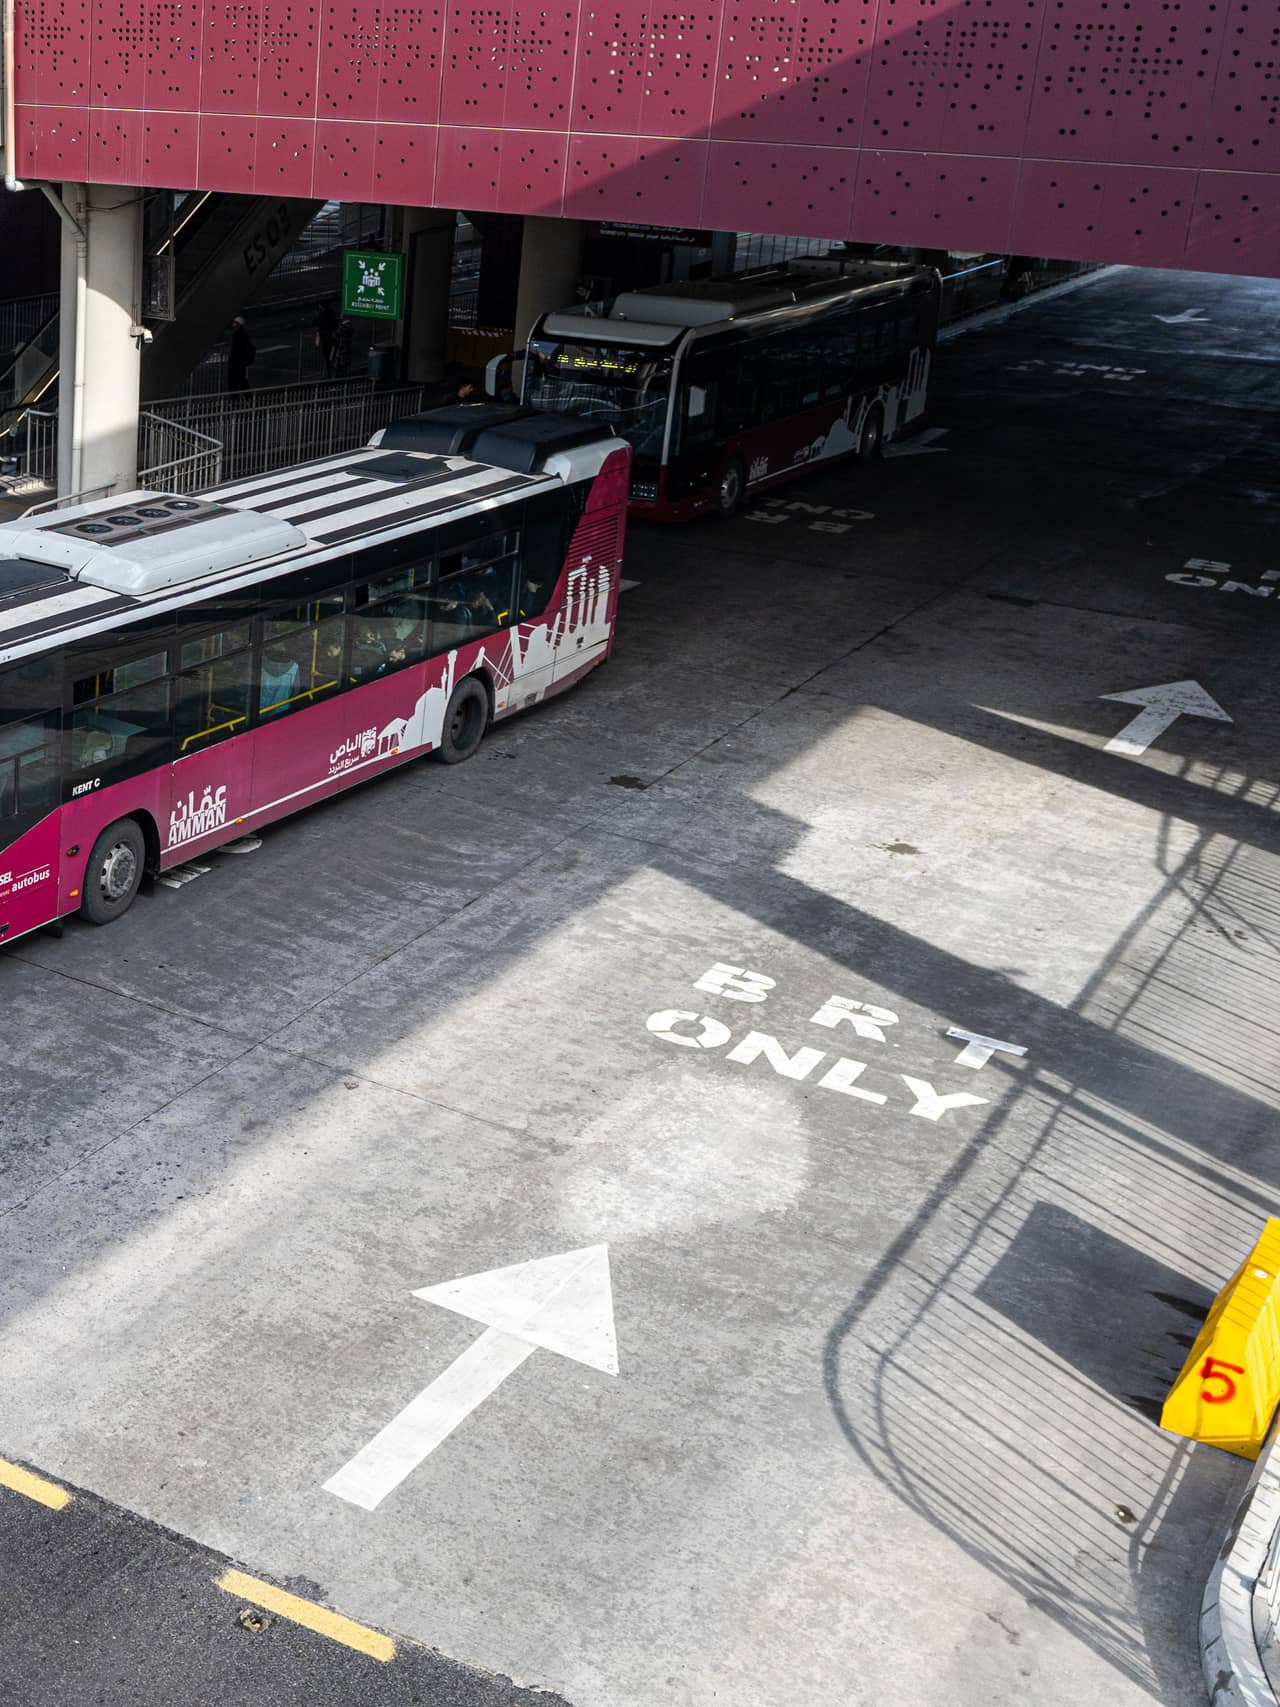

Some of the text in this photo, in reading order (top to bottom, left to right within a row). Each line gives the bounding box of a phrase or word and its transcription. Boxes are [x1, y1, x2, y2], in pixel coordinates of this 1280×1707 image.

[329, 733, 362, 764] الباص
[72, 777, 101, 797] KENT C
[167, 802, 227, 847] AMMAN
[11, 869, 51, 893] autobus
[646, 1009, 991, 1121] ONLY
[1199, 1356, 1245, 1405] 5
